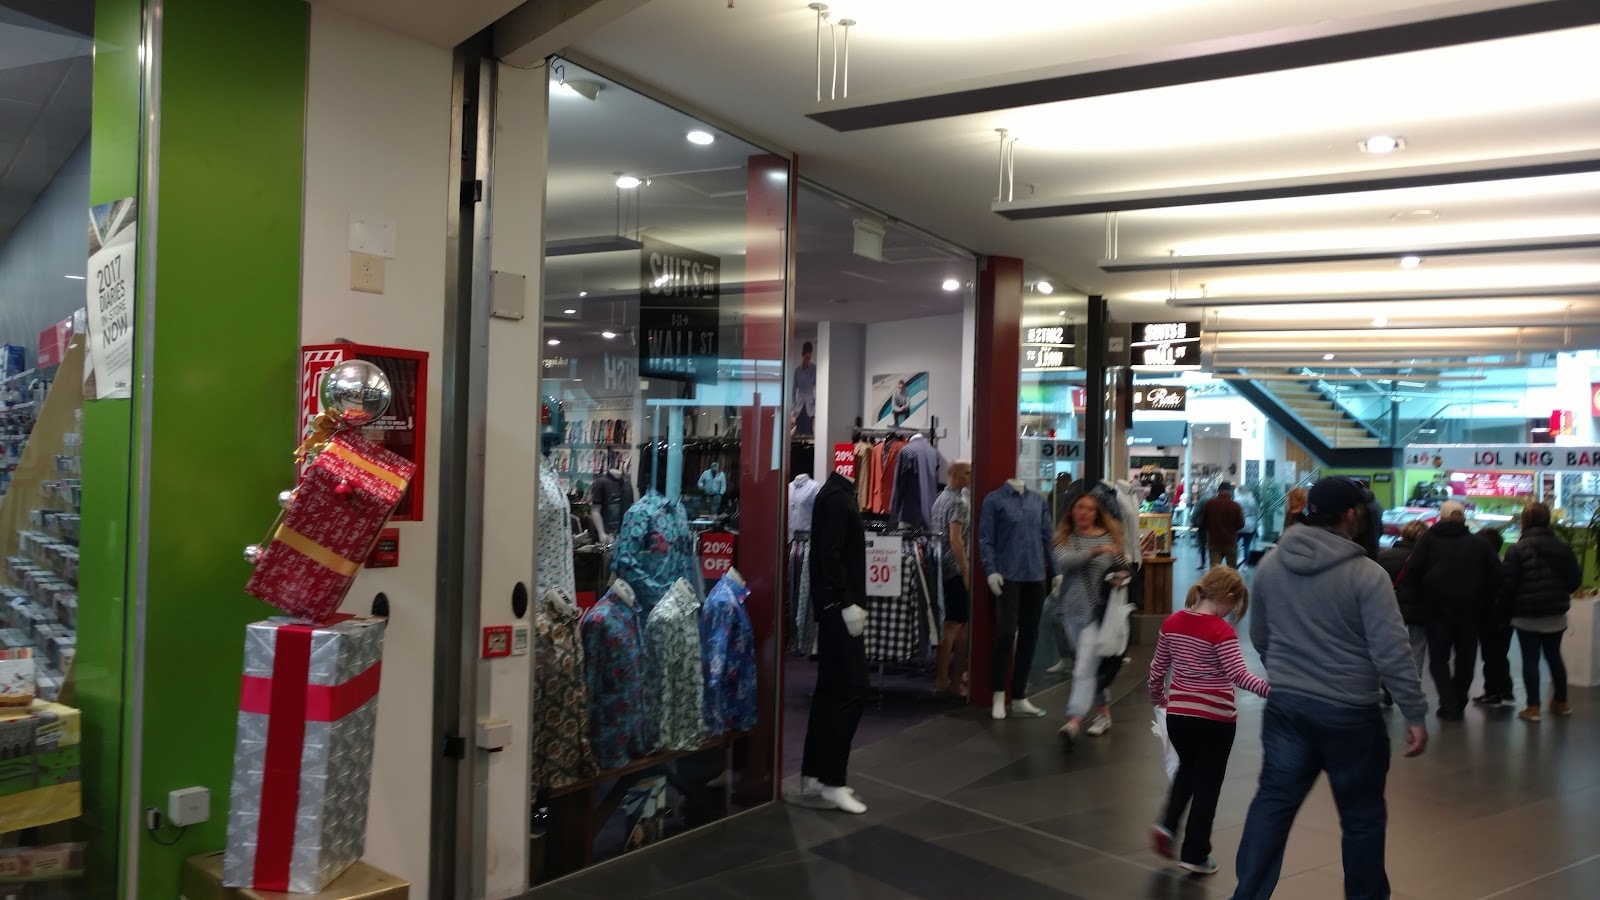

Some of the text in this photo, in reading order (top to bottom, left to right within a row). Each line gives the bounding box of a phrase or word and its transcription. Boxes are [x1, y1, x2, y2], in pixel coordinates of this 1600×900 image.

[97, 254, 121, 293] 2017
[649, 251, 700, 298] SUITS
[99, 280, 126, 313] DIARIES
[103, 313, 129, 349] NOW
[648, 329, 714, 373] WALL ST
[835, 450, 855, 461] 20%
[1474, 451, 1600, 466] LOL NRG BAR
[836, 465, 854, 475] OFF
[703, 542, 733, 554] 20%
[704, 558, 731, 570] OFF
